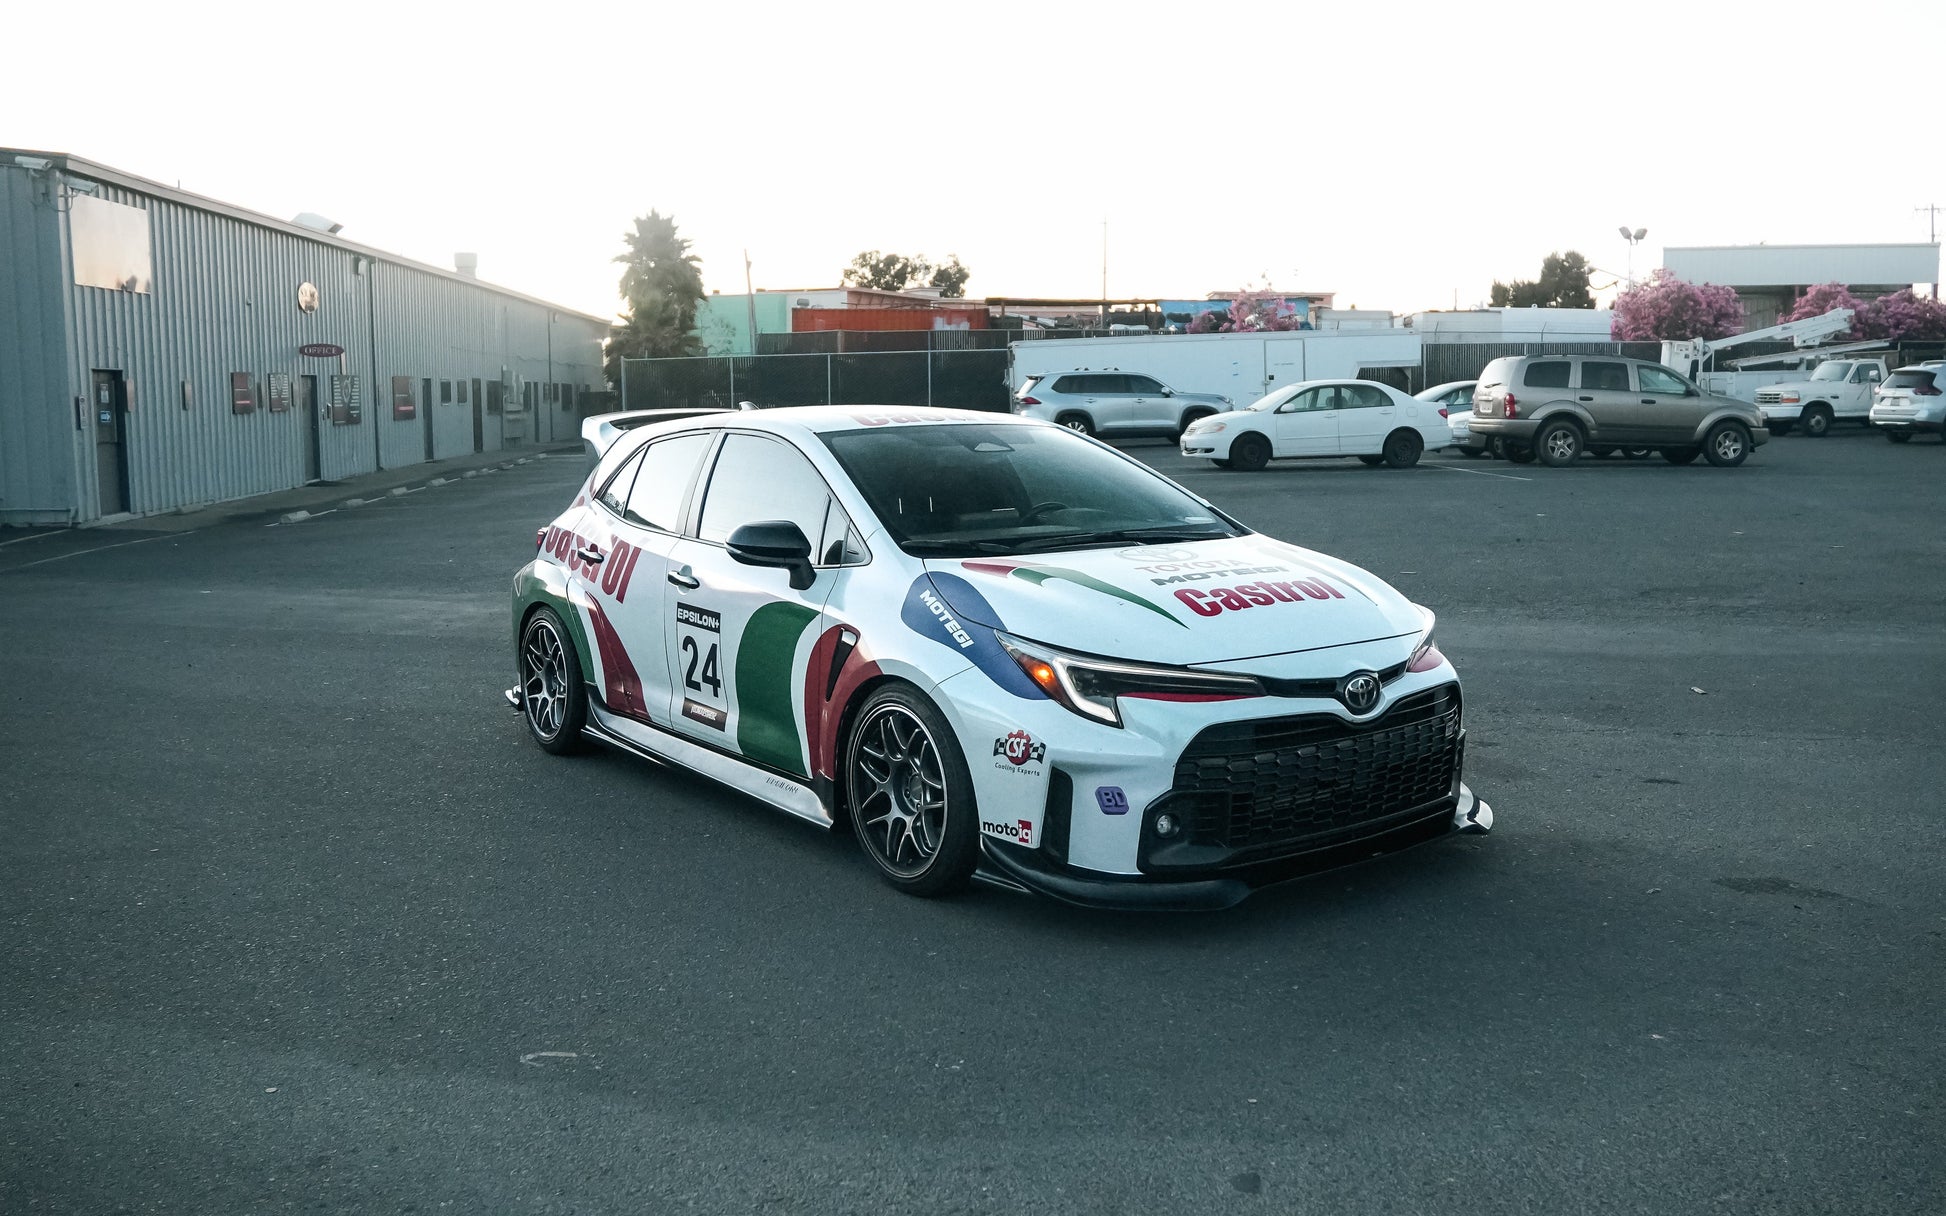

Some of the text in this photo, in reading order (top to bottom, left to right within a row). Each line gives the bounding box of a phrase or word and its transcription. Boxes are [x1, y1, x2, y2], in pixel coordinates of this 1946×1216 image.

[304, 346, 337, 354] OFFICE
[1134, 559, 1254, 574] TOYOTA
[1150, 566, 1290, 586] MOTEGI
[1173, 577, 1346, 617] Castrol
[677, 607, 720, 629] EPSILON+
[920, 589, 975, 649] MOTEGI
[682, 635, 721, 698] 24
[1005, 737, 1027, 758] CSF
[994, 762, 1040, 777] Cooling Experts
[983, 820, 1032, 844] motoiq
